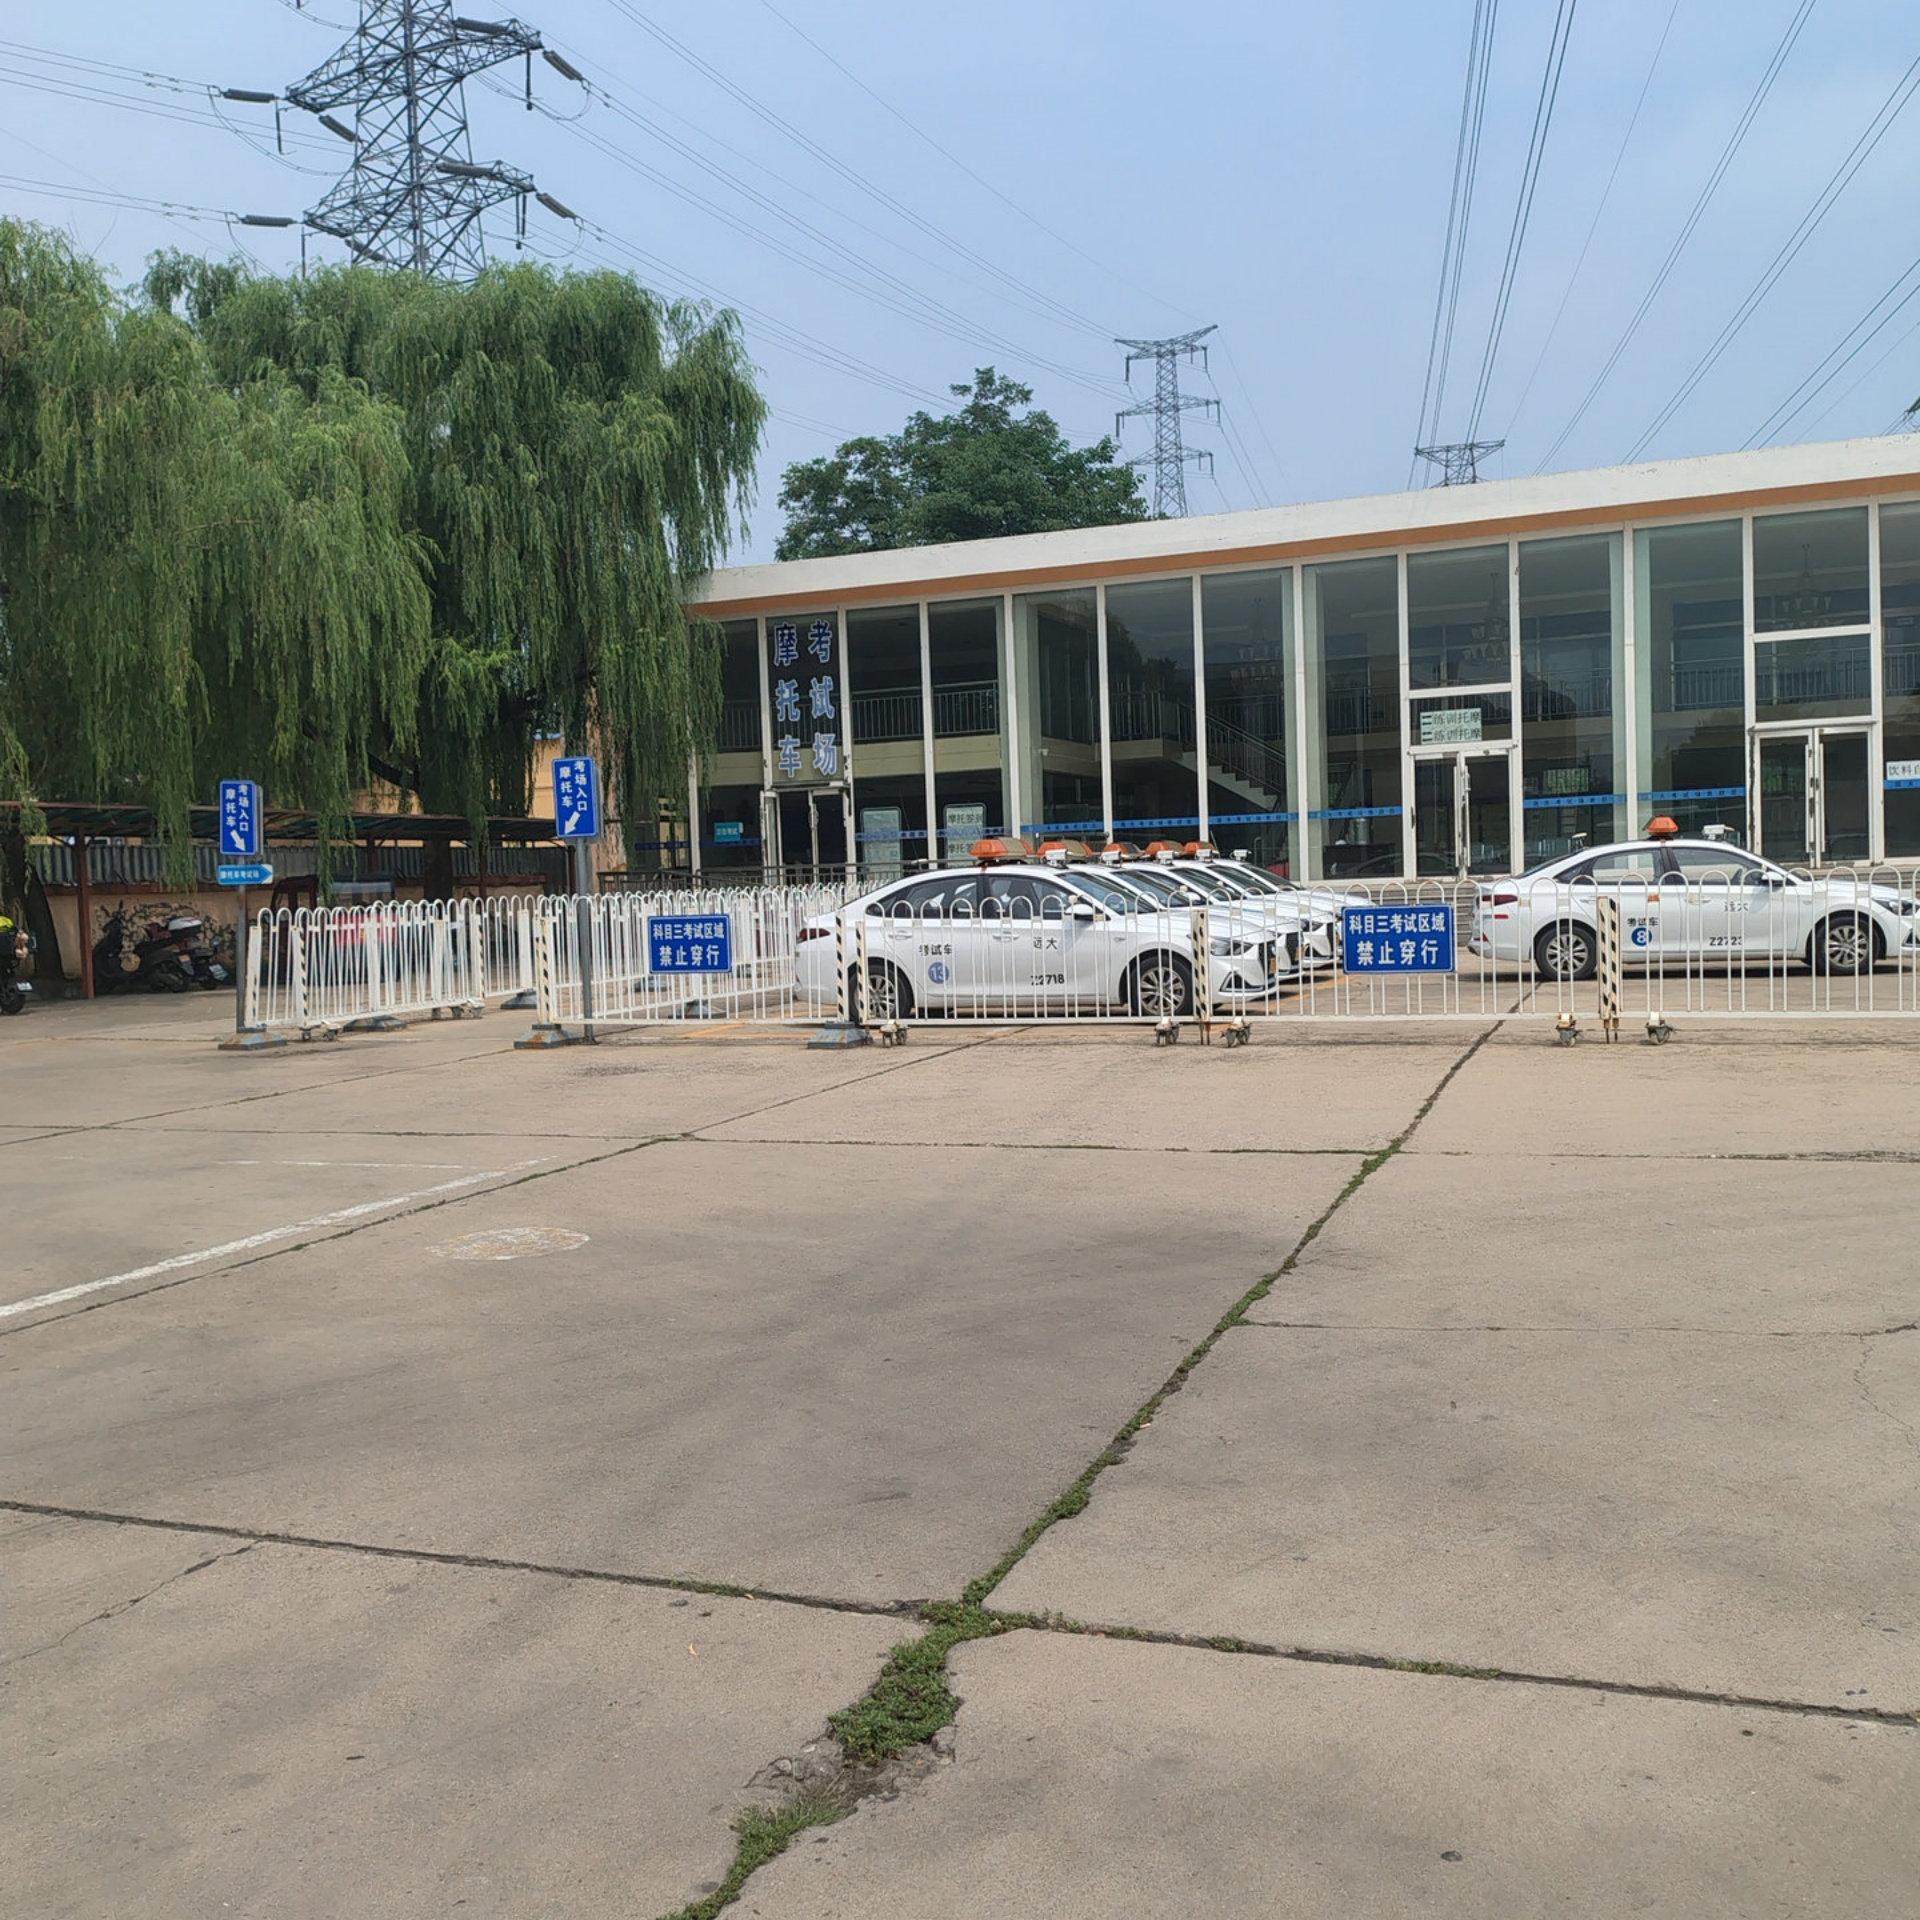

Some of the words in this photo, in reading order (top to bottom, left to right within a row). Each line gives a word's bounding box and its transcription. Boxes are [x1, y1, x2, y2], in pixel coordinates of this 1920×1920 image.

[773, 621, 803, 779] 摩托车
[807, 618, 838, 777] 考试场
[559, 766, 573, 808] 摩托车
[574, 760, 588, 811] 考场入口
[225, 788, 237, 827] 摩托车
[238, 784, 249, 832] 考场入口
[652, 921, 725, 941] 科目三考试区域
[1349, 911, 1446, 935] 科目三考试区域
[1627, 917, 1660, 927] 考试车
[659, 944, 720, 967] 禁止穿行
[1033, 936, 1058, 950] 远大
[1356, 938, 1439, 966] 禁止穿行
